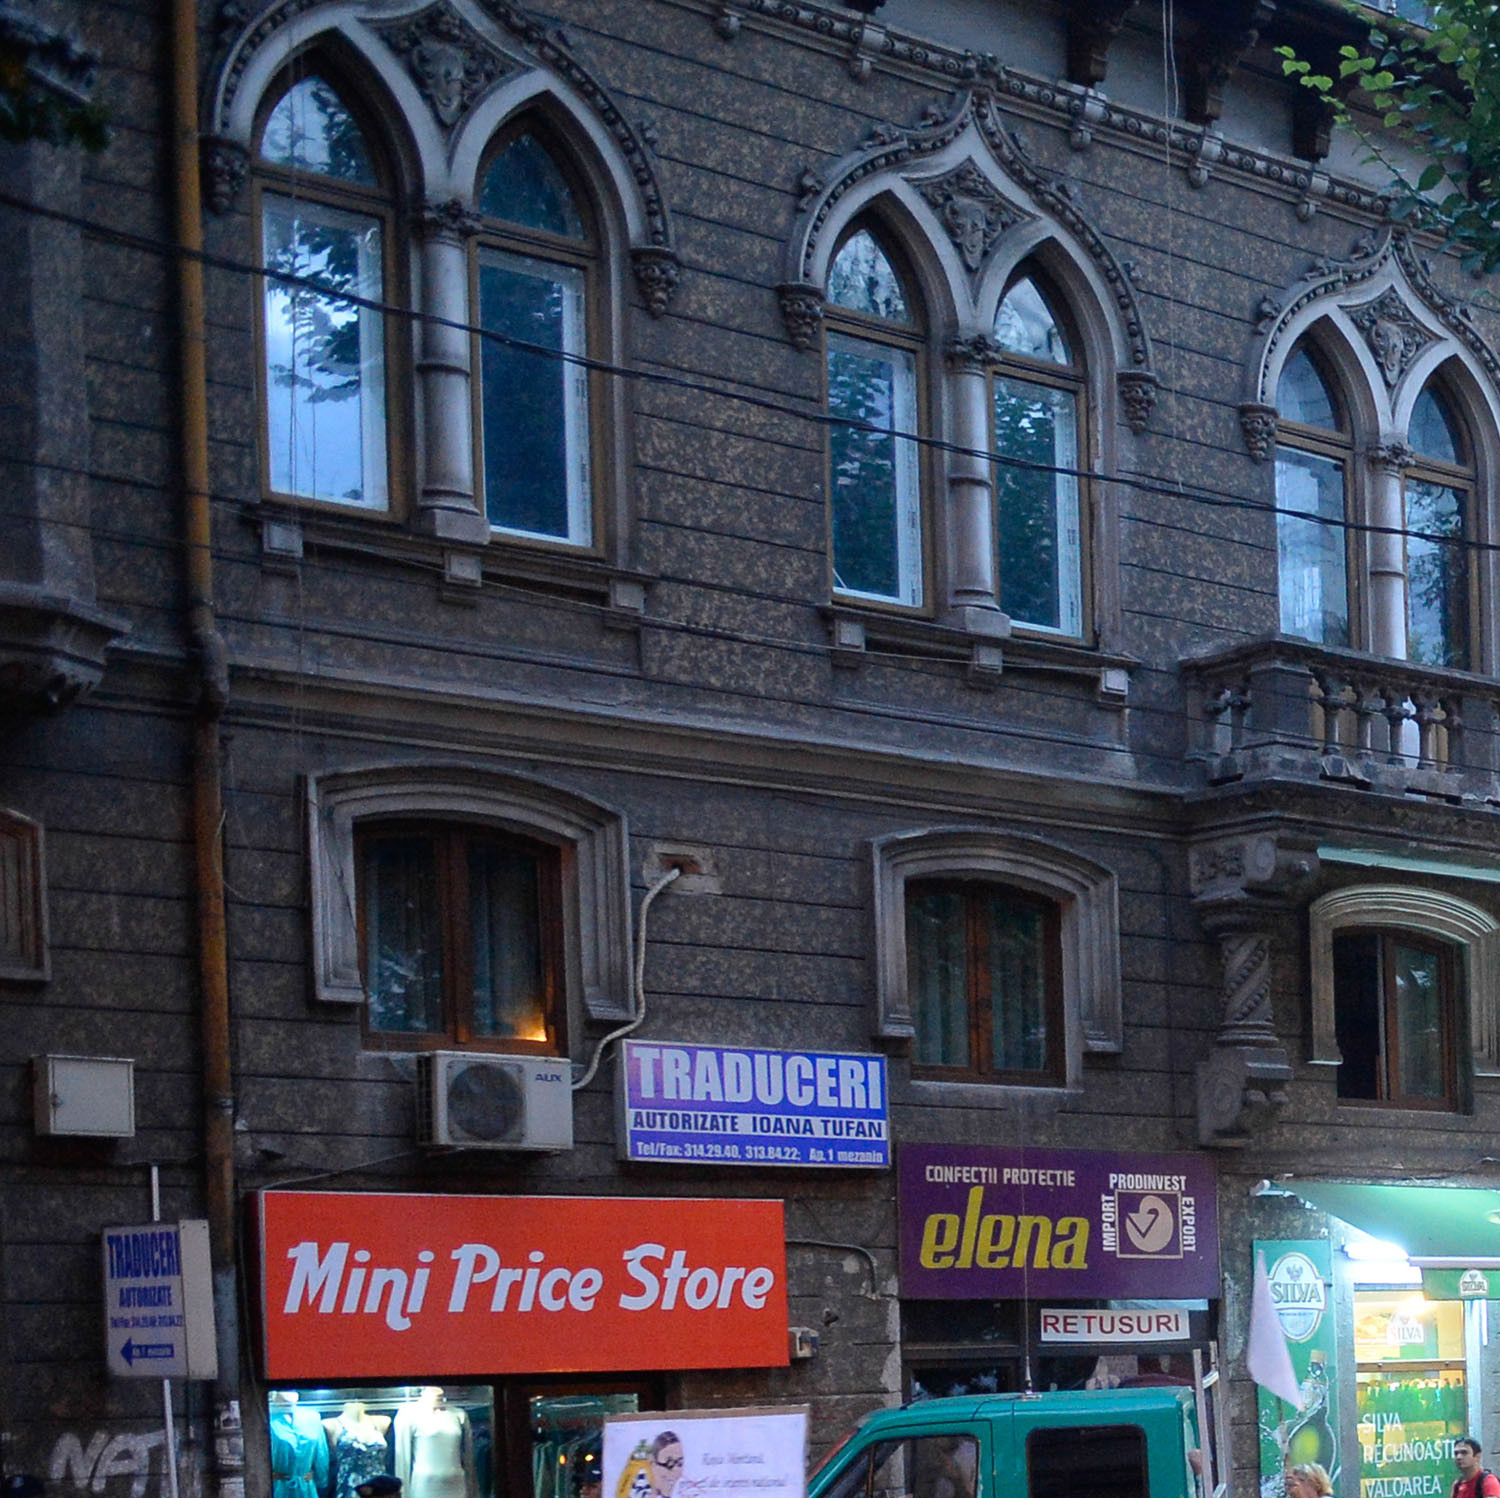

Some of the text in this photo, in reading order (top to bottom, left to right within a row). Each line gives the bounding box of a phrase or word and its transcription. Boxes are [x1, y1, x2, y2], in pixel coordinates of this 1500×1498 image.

[632, 1047, 881, 1110] TRADUCERI
[634, 1110, 882, 1138] AUTORIZATE IOANA TUFAN
[1109, 1173, 1187, 1191] PRODINVEST
[919, 1185, 1090, 1270] elena
[1102, 1194, 1116, 1252] IMPORT
[1181, 1197, 1196, 1253] EXPORT
[106, 1231, 181, 1279] TRADUCERI
[283, 1241, 774, 1331] Mini Price Store
[1271, 1282, 1322, 1304] SILVA
[1043, 1314, 1180, 1334] RETUSURI
[1362, 1412, 1402, 1434] SILVA
[1366, 1475, 1442, 1498] VALOAREA
